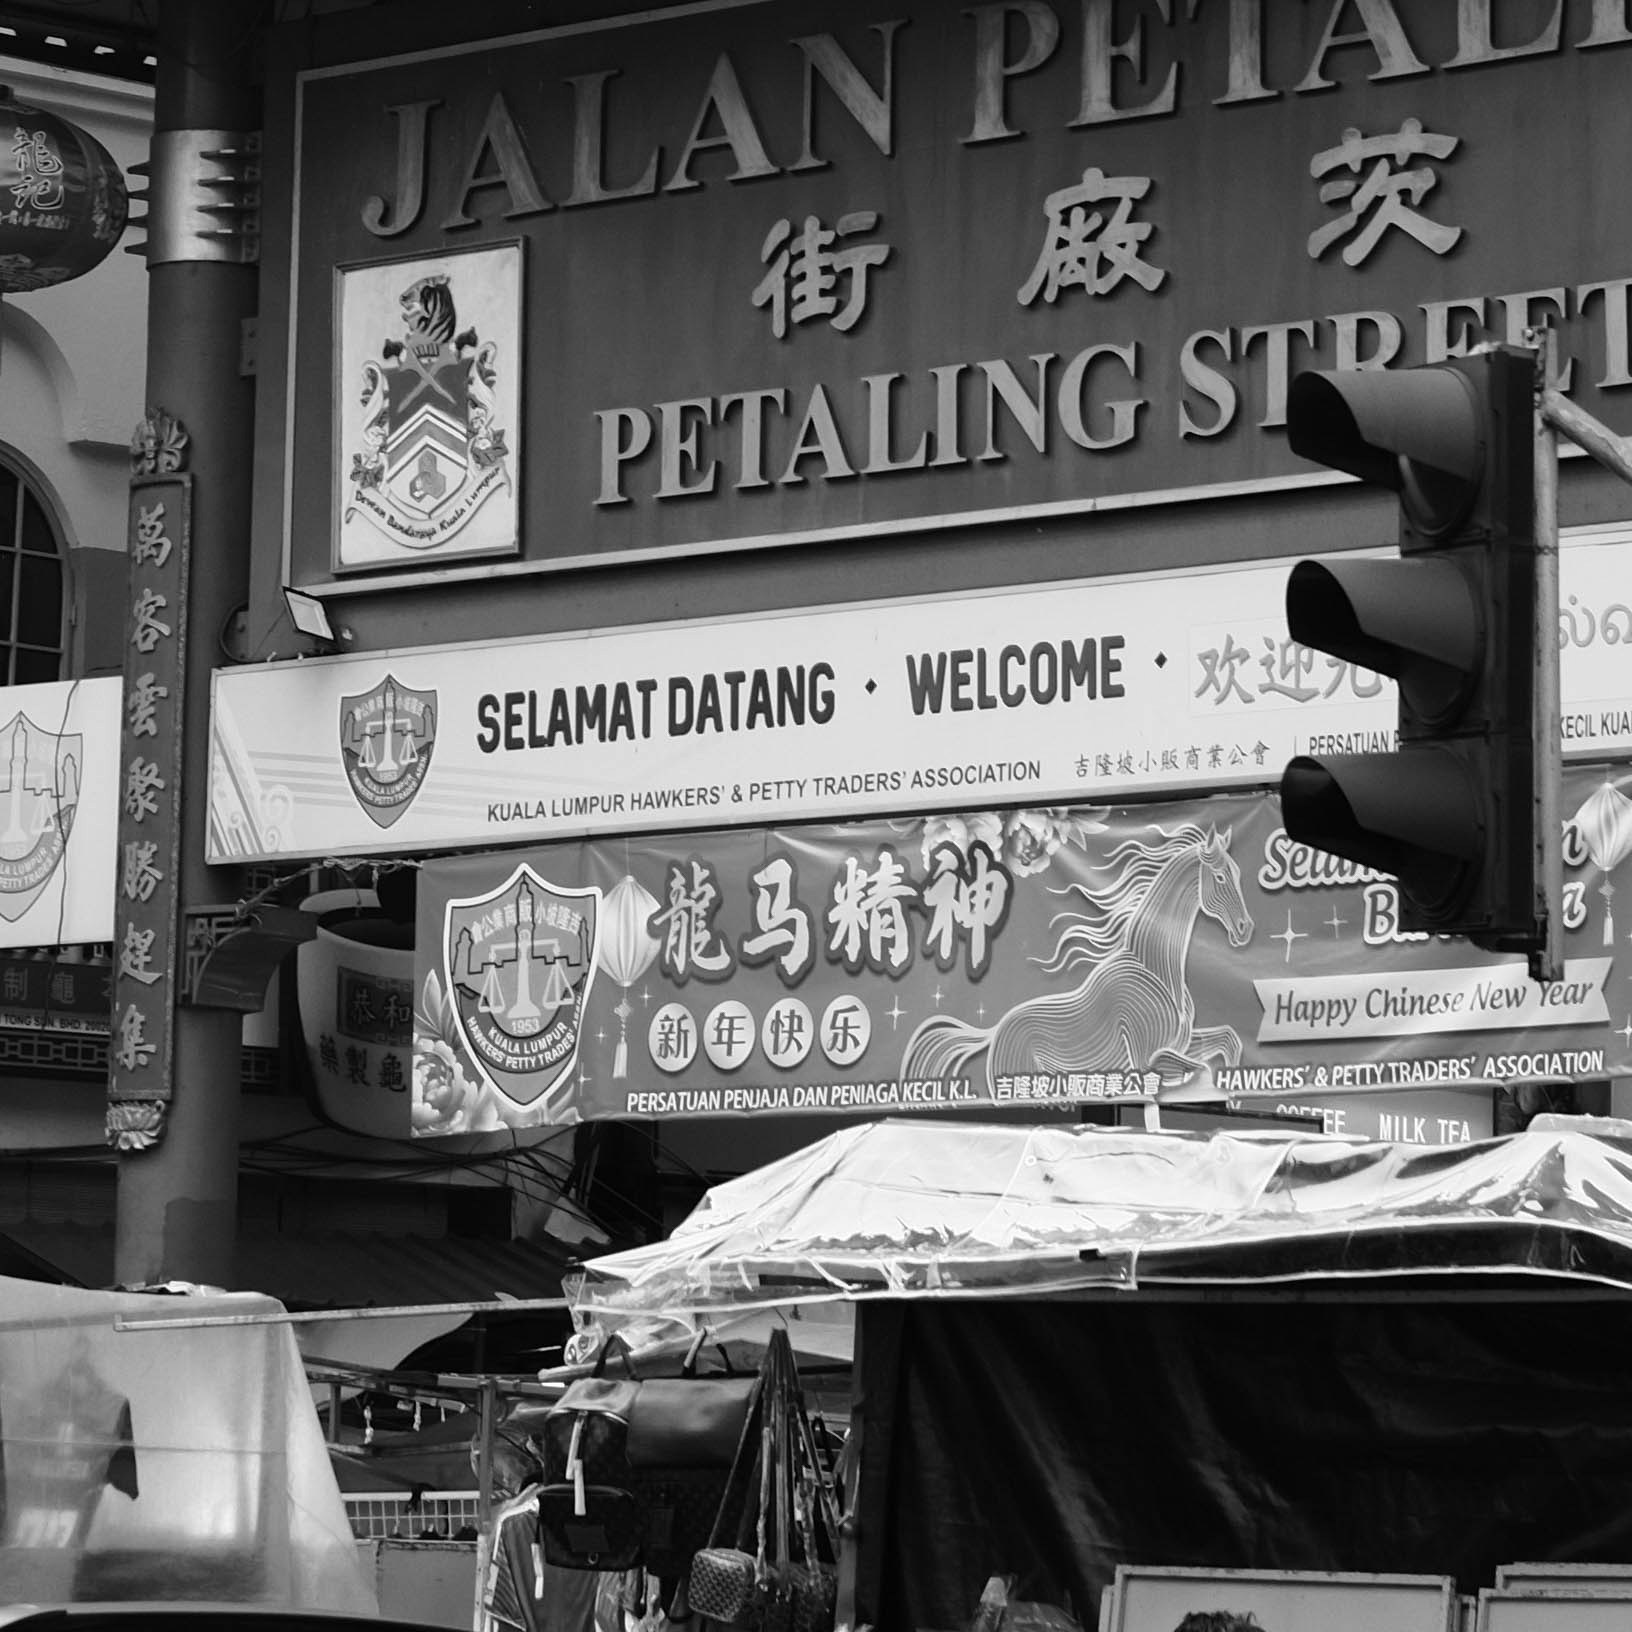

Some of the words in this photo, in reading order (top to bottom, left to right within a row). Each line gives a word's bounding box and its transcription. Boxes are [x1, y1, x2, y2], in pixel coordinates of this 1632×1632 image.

[360, 15, 913, 239] JALAN
[592, 340, 1149, 508] PETALING
[1194, 633, 1388, 705] 欢迎光
[476, 678, 659, 754] SELAMAT
[667, 661, 836, 735] DATANG
[905, 634, 1126, 716] WELCOME
[1309, 730, 1389, 756] PERSATUAN
[487, 799, 547, 823] KUALA
[551, 793, 626, 818] LUMPUR
[630, 784, 727, 813] HAWKERS'
[730, 781, 744, 803] &
[749, 777, 808, 802] PETTY
[813, 769, 907, 797] TRADERS'
[911, 759, 1041, 787] ASSOCIATION
[1275, 989, 1356, 1027] Happy
[1363, 986, 1464, 1019] Chinese
[1470, 981, 1527, 1011] New
[1538, 980, 1595, 1007] Year
[488, 1026, 520, 1054] KUALA
[523, 1021, 567, 1054] LUMPUR
[511, 1018, 540, 1033] 1953
[656, 1001, 863, 1059] 新年快乐
[505, 1053, 537, 1069] PETTY
[1314, 1065, 1328, 1088] &
[1331, 1062, 1385, 1087] PETTY
[1482, 1050, 1605, 1079] ASSOCIATION
[627, 1090, 720, 1112] PERSATUAN
[723, 1087, 789, 1110] PENJAJA
[793, 1086, 829, 1107] DAN
[830, 1083, 899, 1106] PENIAGA
[902, 1081, 946, 1102] KECIL
[949, 1079, 977, 1100] K.L.
[1379, 1112, 1426, 1144] MILK
